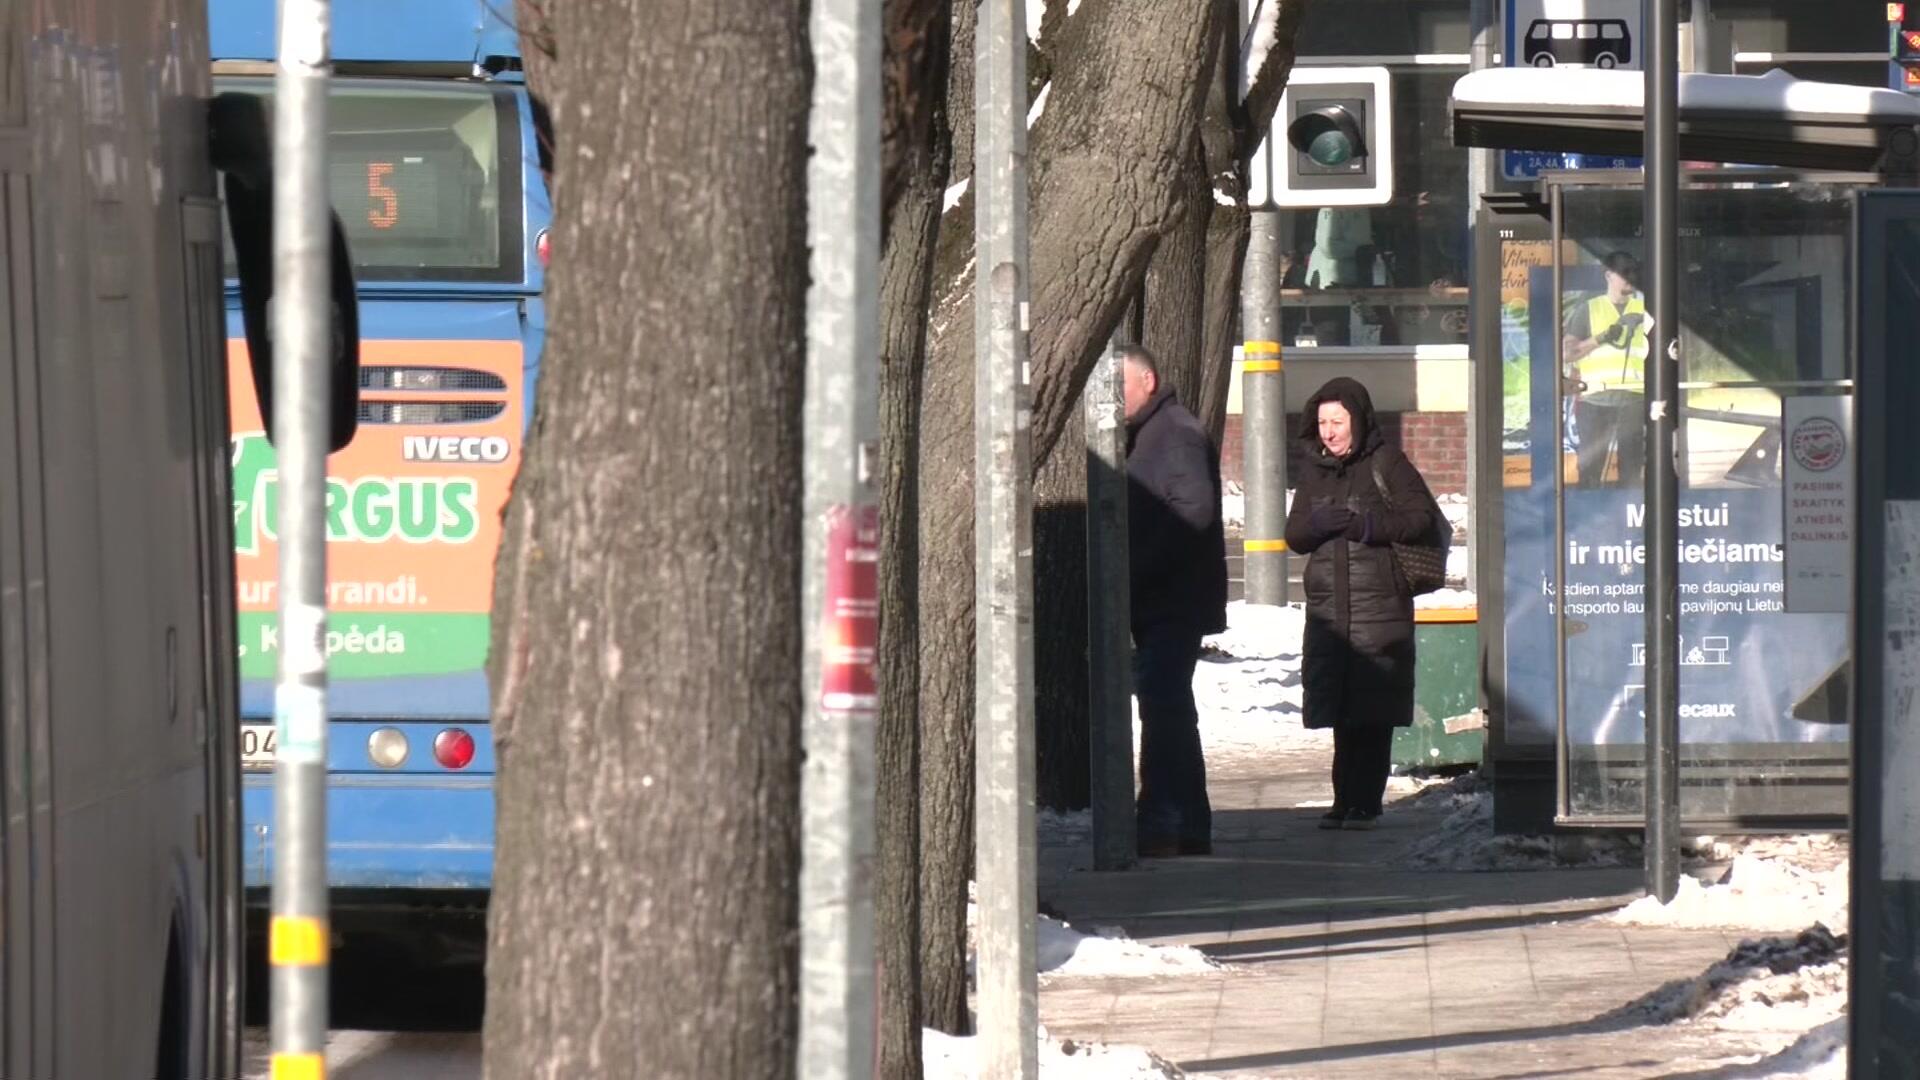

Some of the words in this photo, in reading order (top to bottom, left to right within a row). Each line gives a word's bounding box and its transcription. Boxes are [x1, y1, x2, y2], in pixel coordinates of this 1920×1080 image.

[367, 162, 397, 229] 5
[1499, 231, 1514, 239] 111
[403, 436, 509, 461] IVECO
[1626, 503, 1729, 527] Mstui
[1792, 498, 1845, 508] SKAITYK
[1569, 541, 1590, 564] ir
[1598, 538, 1784, 564] mieiečiams
[1542, 577, 1600, 596] Ksdien
[1703, 580, 1760, 597] daugiau
[1548, 601, 1620, 617] tnsporto
[260, 624, 405, 656] Kpėda
